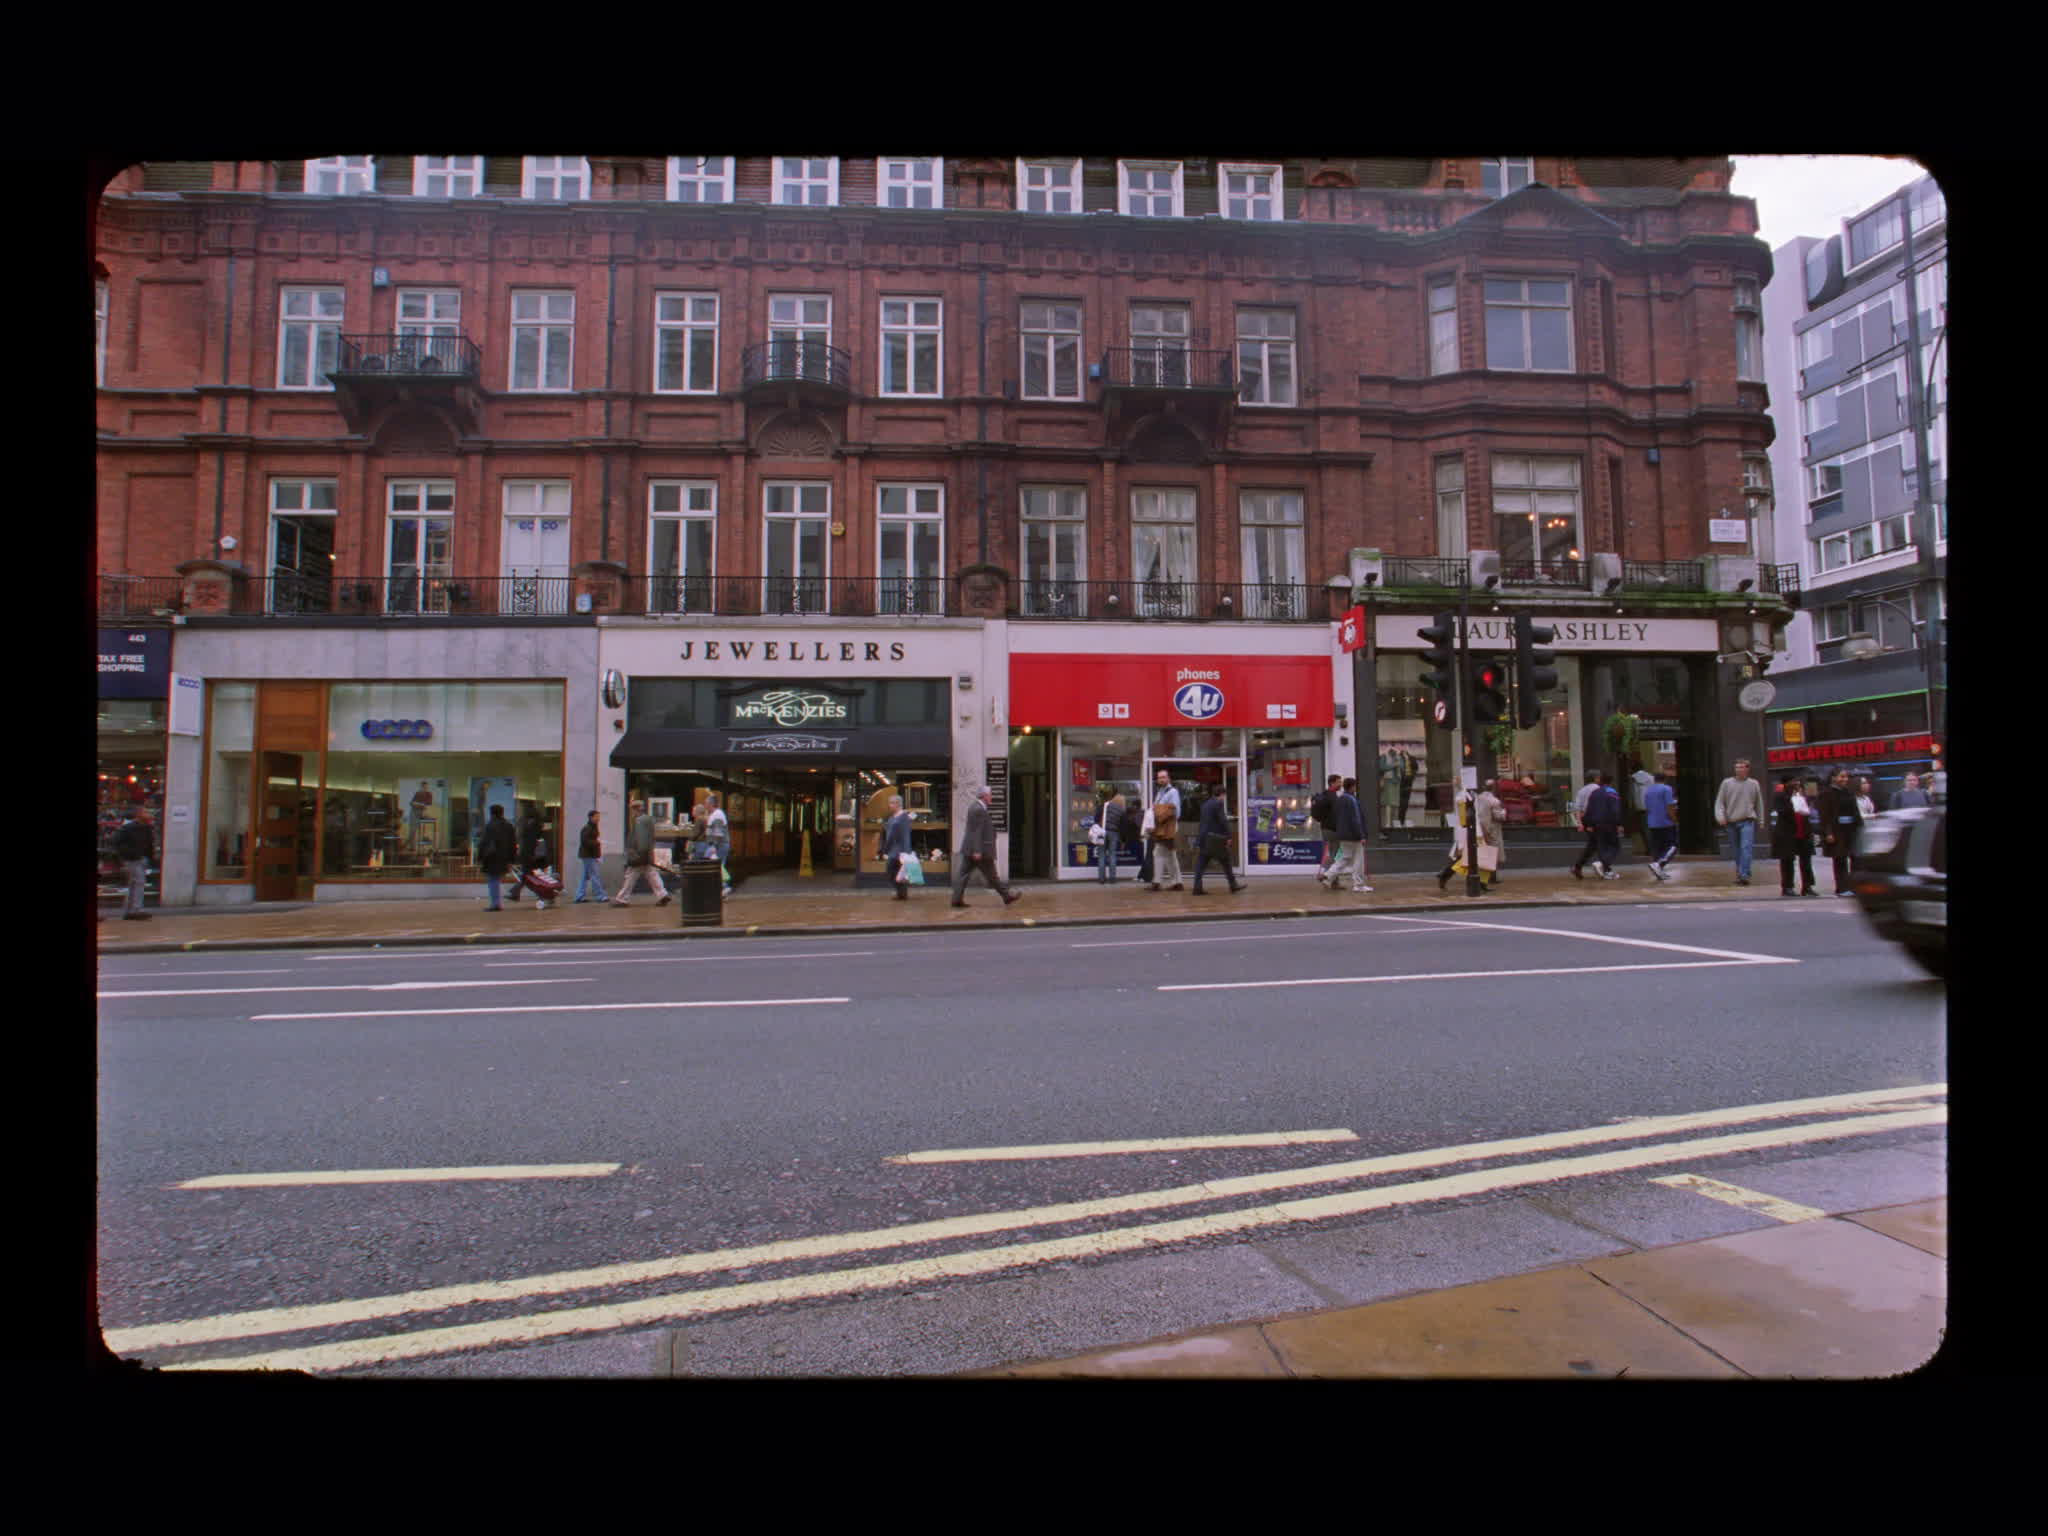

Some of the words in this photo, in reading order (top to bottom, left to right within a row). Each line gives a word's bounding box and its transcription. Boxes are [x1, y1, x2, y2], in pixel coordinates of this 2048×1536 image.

[1552, 623, 1648, 641] ASHLEY
[680, 641, 905, 661] JEWELLERS
[97, 655, 116, 663] TAX
[120, 655, 145, 663] FREE
[97, 664, 145, 672] SHOPPING
[1177, 668, 1220, 682] phones
[1273, 844, 1294, 858] £50
